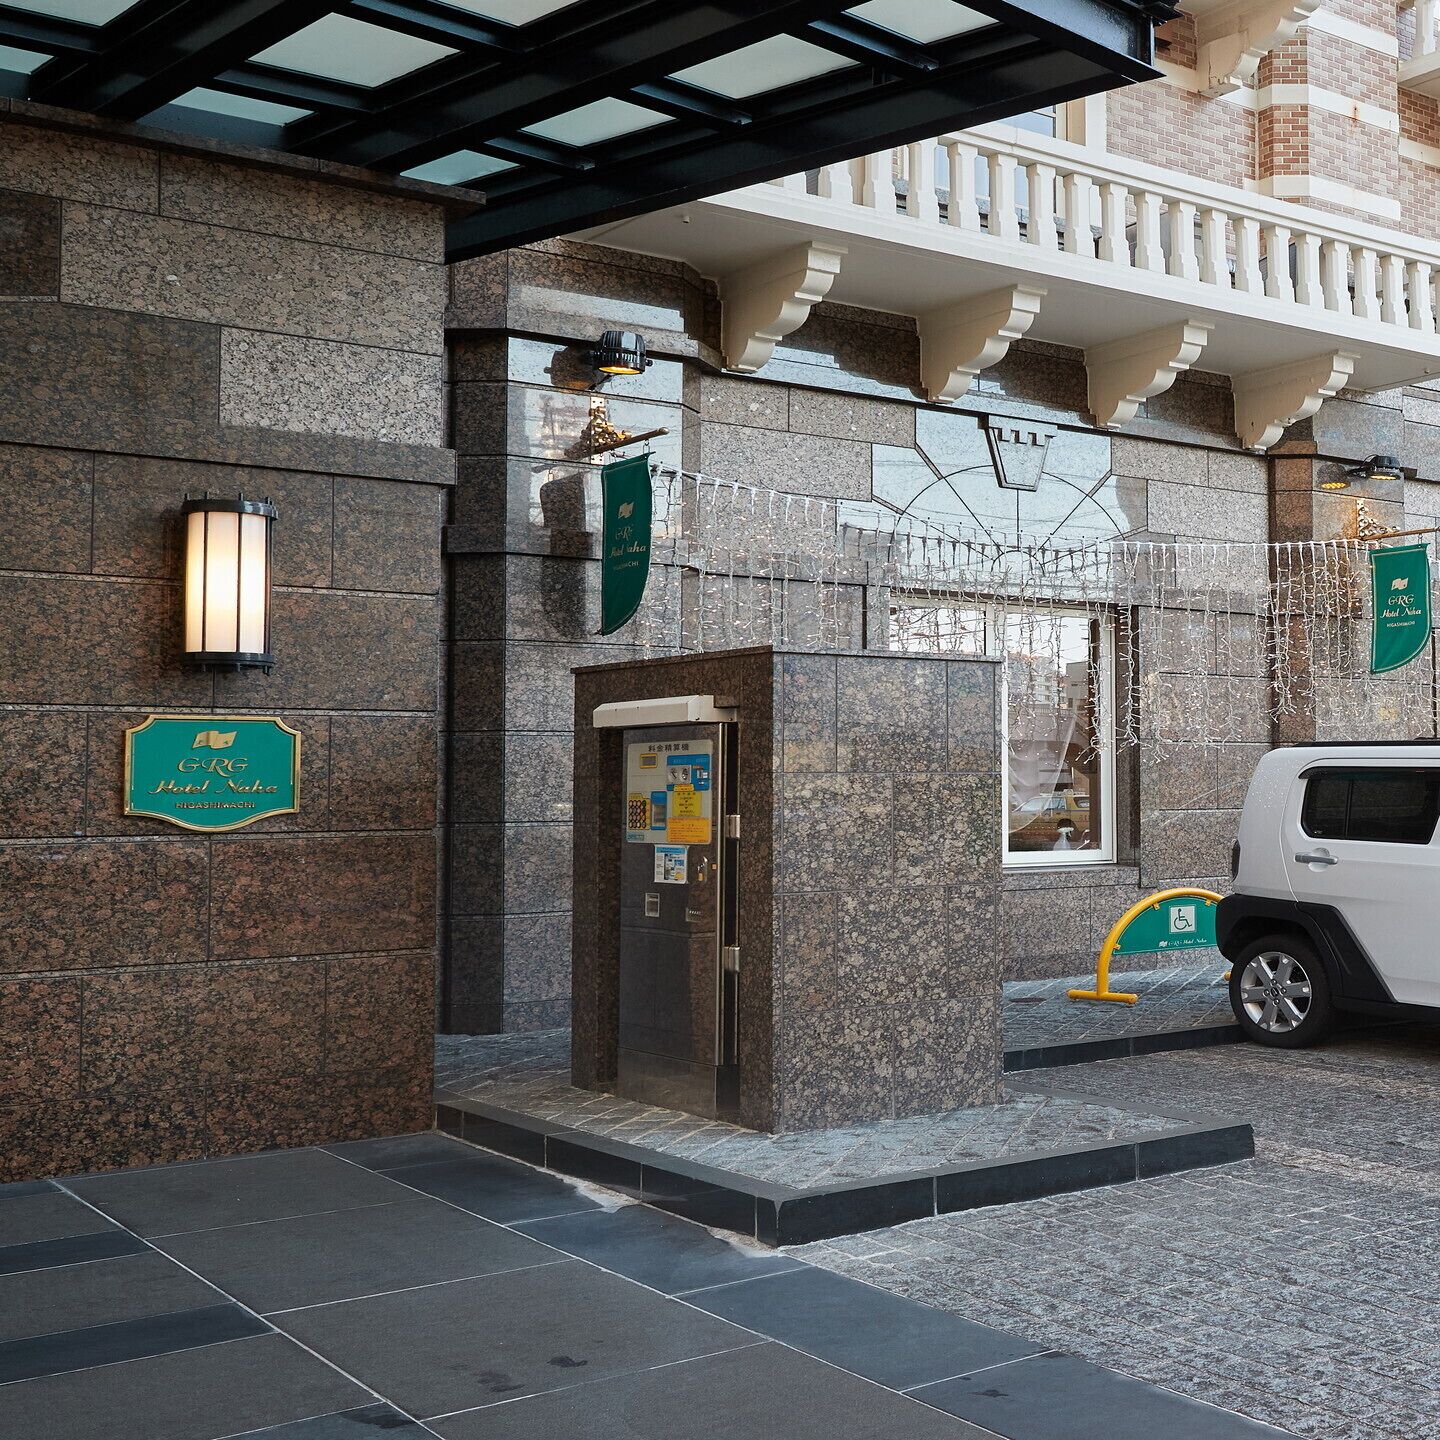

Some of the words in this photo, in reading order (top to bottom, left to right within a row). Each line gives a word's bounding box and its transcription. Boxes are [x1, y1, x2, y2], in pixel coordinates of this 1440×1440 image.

[626, 541, 647, 553] aha
[1388, 594, 1415, 607] GRG
[1379, 608, 1400, 619] Hotel
[1401, 606, 1422, 617] Naha
[648, 743, 690, 753] 料金精算機
[177, 757, 248, 778] GRG
[148, 780, 210, 795] Hotel
[215, 778, 278, 794] Naha
